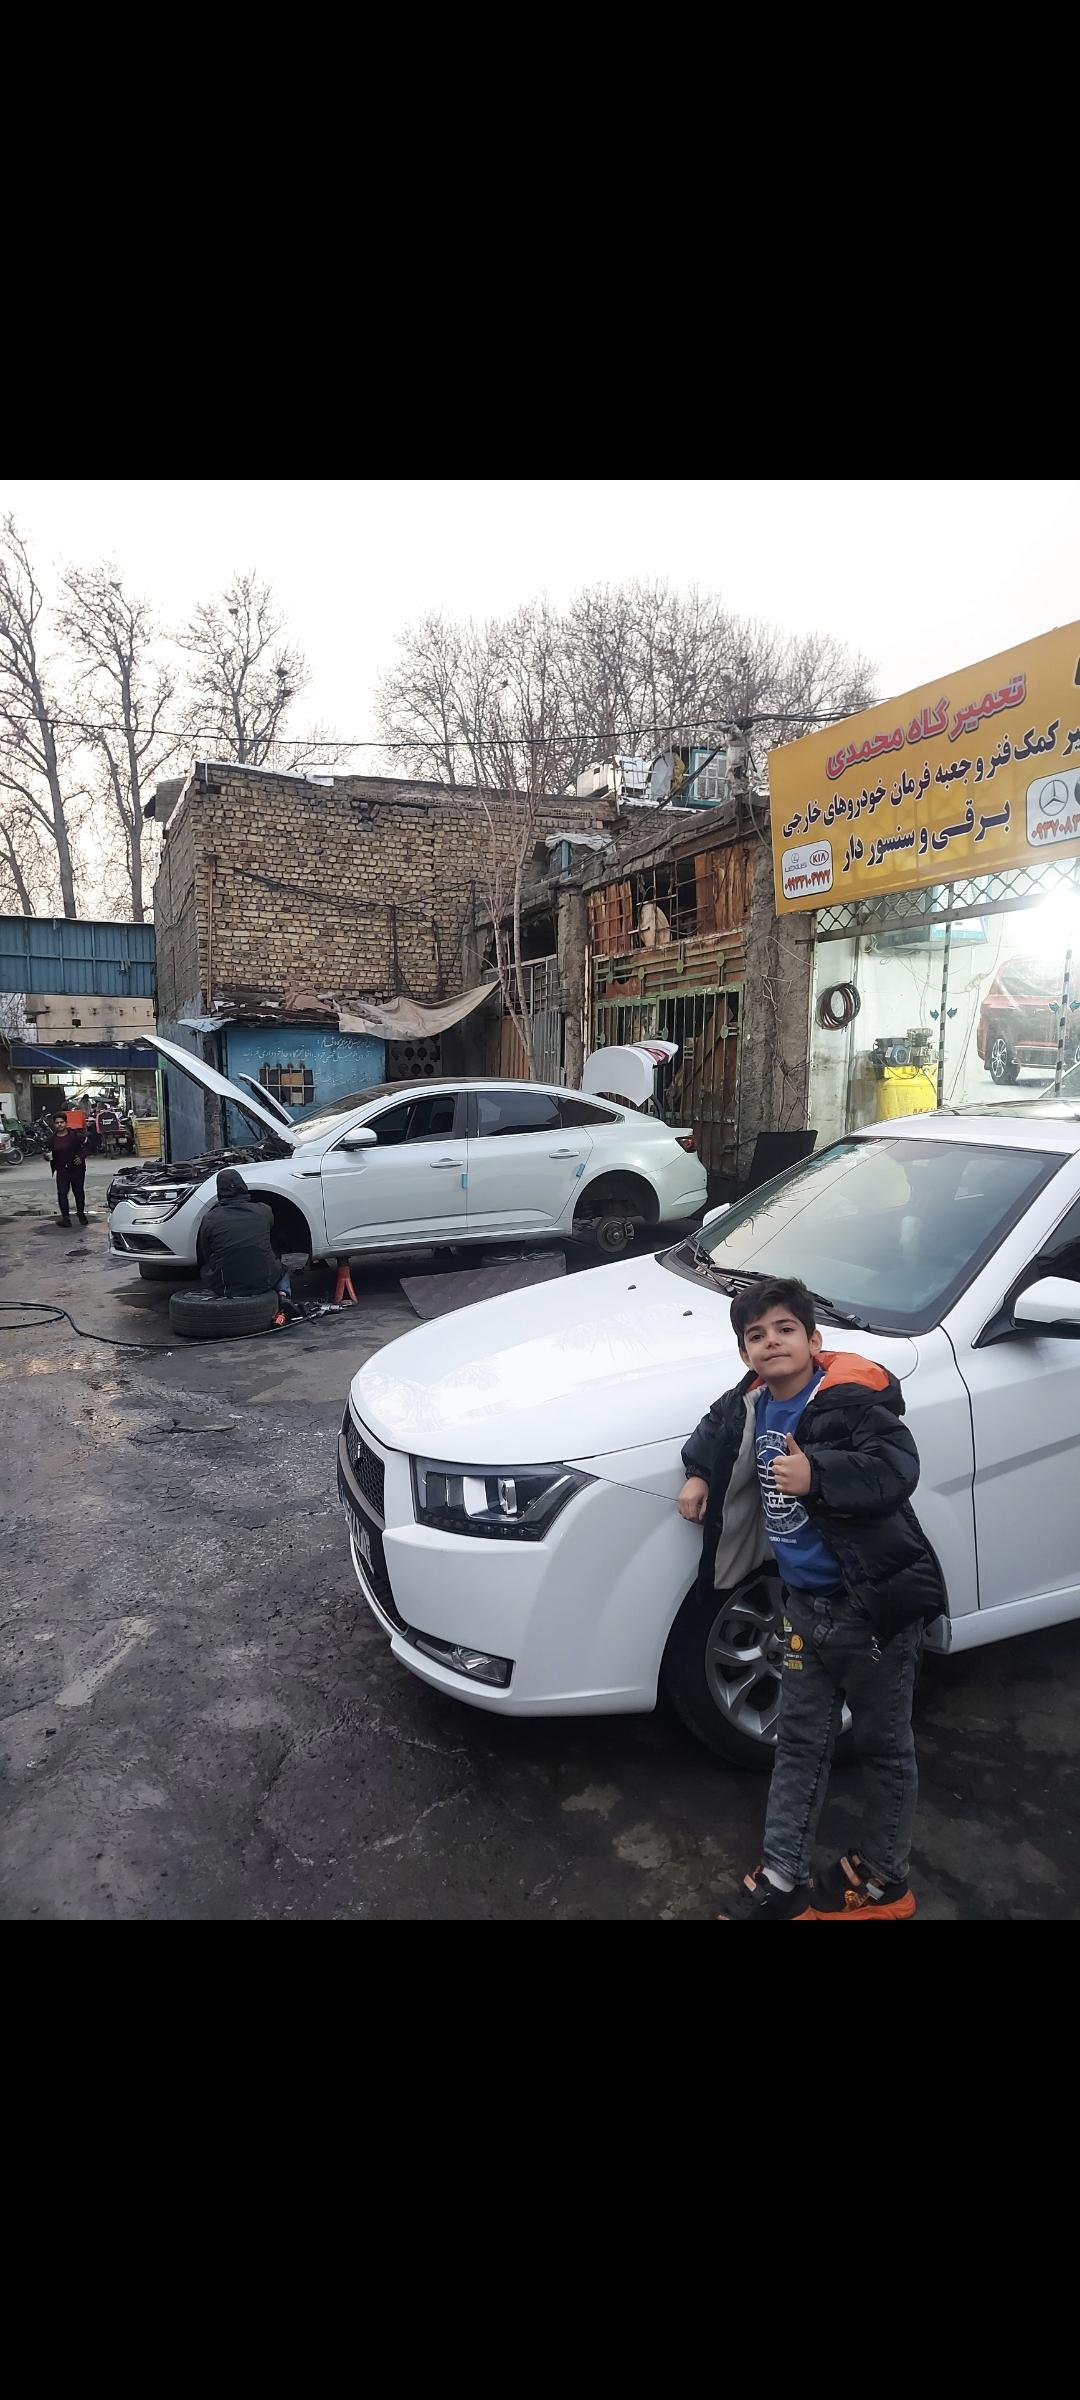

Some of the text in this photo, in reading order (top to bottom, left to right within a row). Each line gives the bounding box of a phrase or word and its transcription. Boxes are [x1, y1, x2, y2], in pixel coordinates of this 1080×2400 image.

[825, 725, 904, 780] محمدی
[986, 734, 1011, 779] فنر
[1014, 720, 1059, 760] کمک
[890, 761, 931, 806] فرمان
[935, 758, 972, 791] جعبه
[974, 757, 985, 782] و
[783, 800, 822, 838] خارجی
[823, 778, 886, 826] خودروهای
[918, 826, 928, 855] و
[931, 799, 1011, 850] برقی
[842, 834, 864, 872] دار
